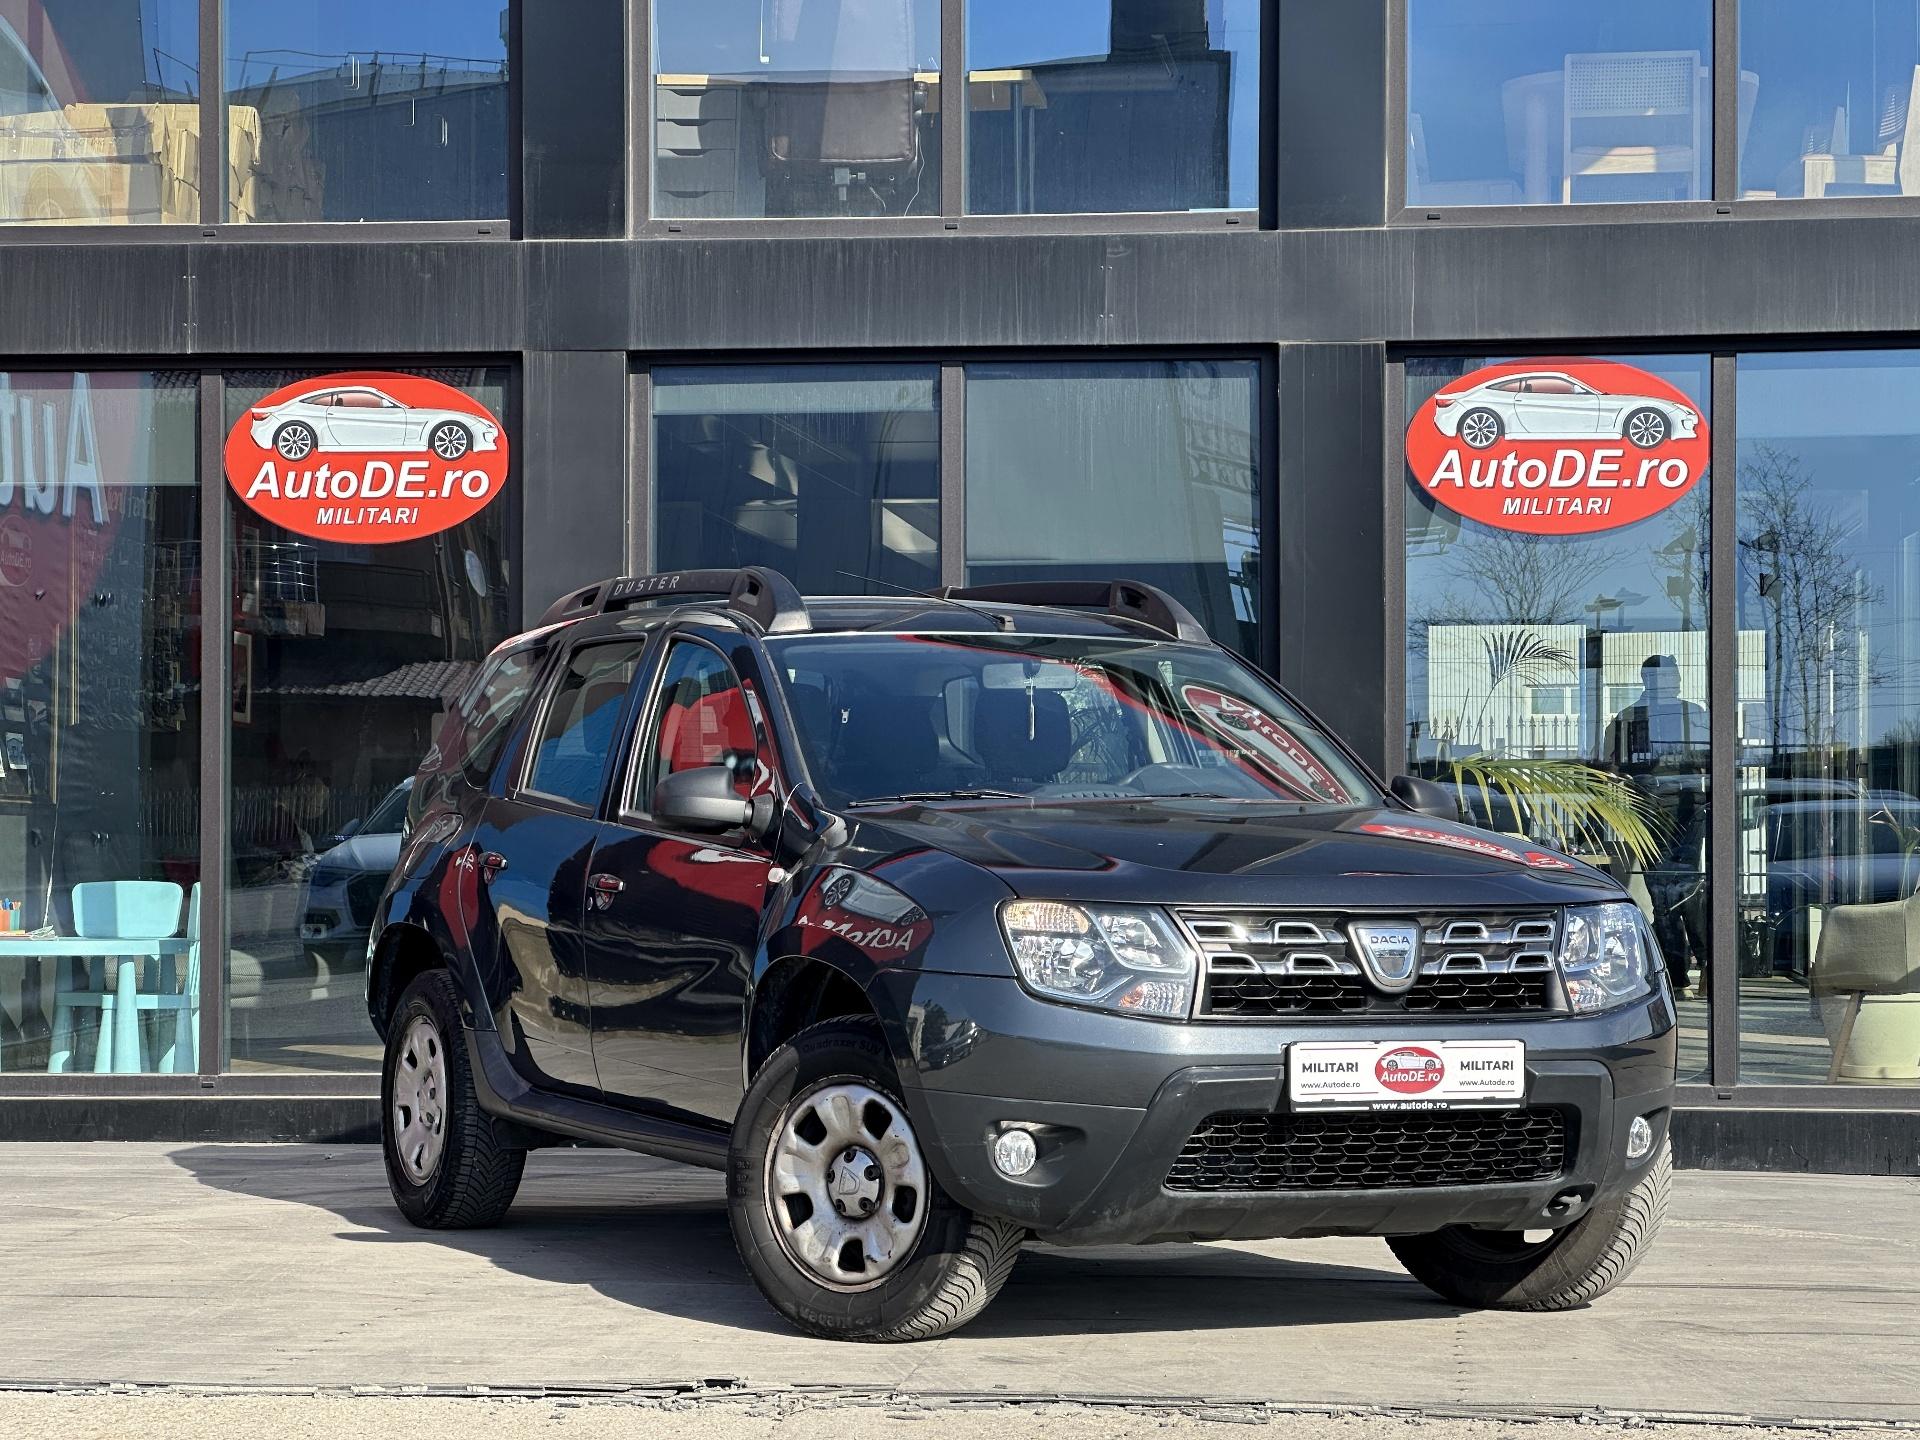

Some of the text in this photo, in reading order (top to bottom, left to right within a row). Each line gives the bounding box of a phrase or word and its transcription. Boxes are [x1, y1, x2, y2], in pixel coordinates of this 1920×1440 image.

[1428, 448, 1689, 488] AutoDE.ro
[245, 460, 490, 500] AutoDE.ro
[1502, 497, 1612, 515] MILITARI
[316, 507, 419, 526] MILITARI
[614, 575, 680, 596] DUSTER
[1370, 935, 1411, 945] DACIA
[1301, 1062, 1359, 1073] MILITARI
[1460, 1060, 1514, 1071] MILITARI
[1380, 1070, 1441, 1083] AutoDE.ro
[1459, 1078, 1515, 1087] www.Autode.ro
[1300, 1080, 1361, 1089] www.Autode.ro
[1372, 1102, 1448, 1111] www.autode.ro
